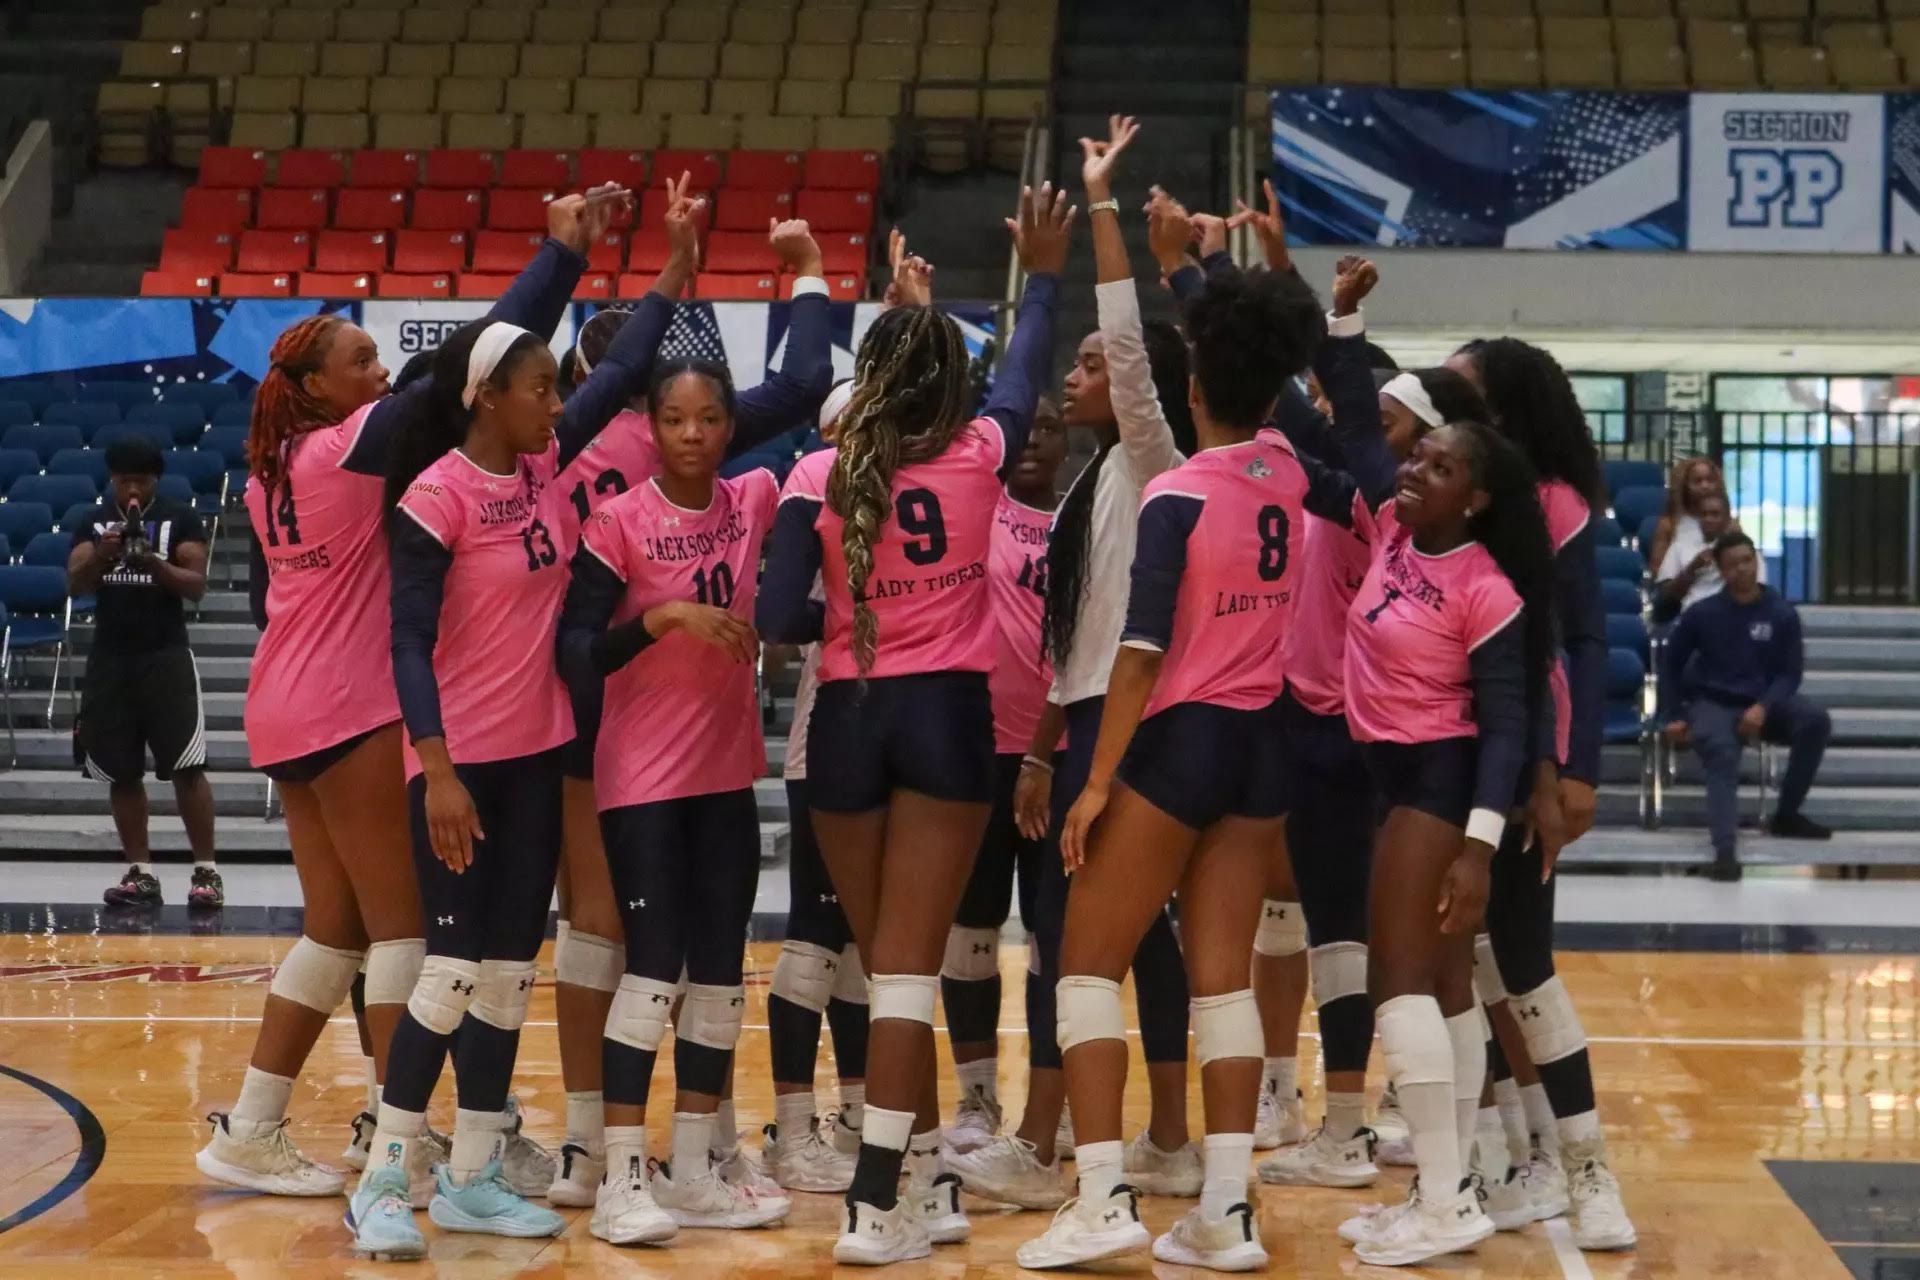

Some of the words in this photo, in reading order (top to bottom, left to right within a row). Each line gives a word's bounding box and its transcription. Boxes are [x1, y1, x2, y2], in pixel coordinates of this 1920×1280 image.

[1723, 110, 1851, 142] SECTION
[1728, 149, 1843, 228] PP
[264, 478, 302, 547] 14
[896, 487, 948, 567] 9
[522, 518, 557, 572] 13
[646, 531, 716, 562] JACKSON
[1257, 505, 1290, 582] 8
[693, 561, 735, 609] 10
[1215, 592, 1258, 618] LADY
